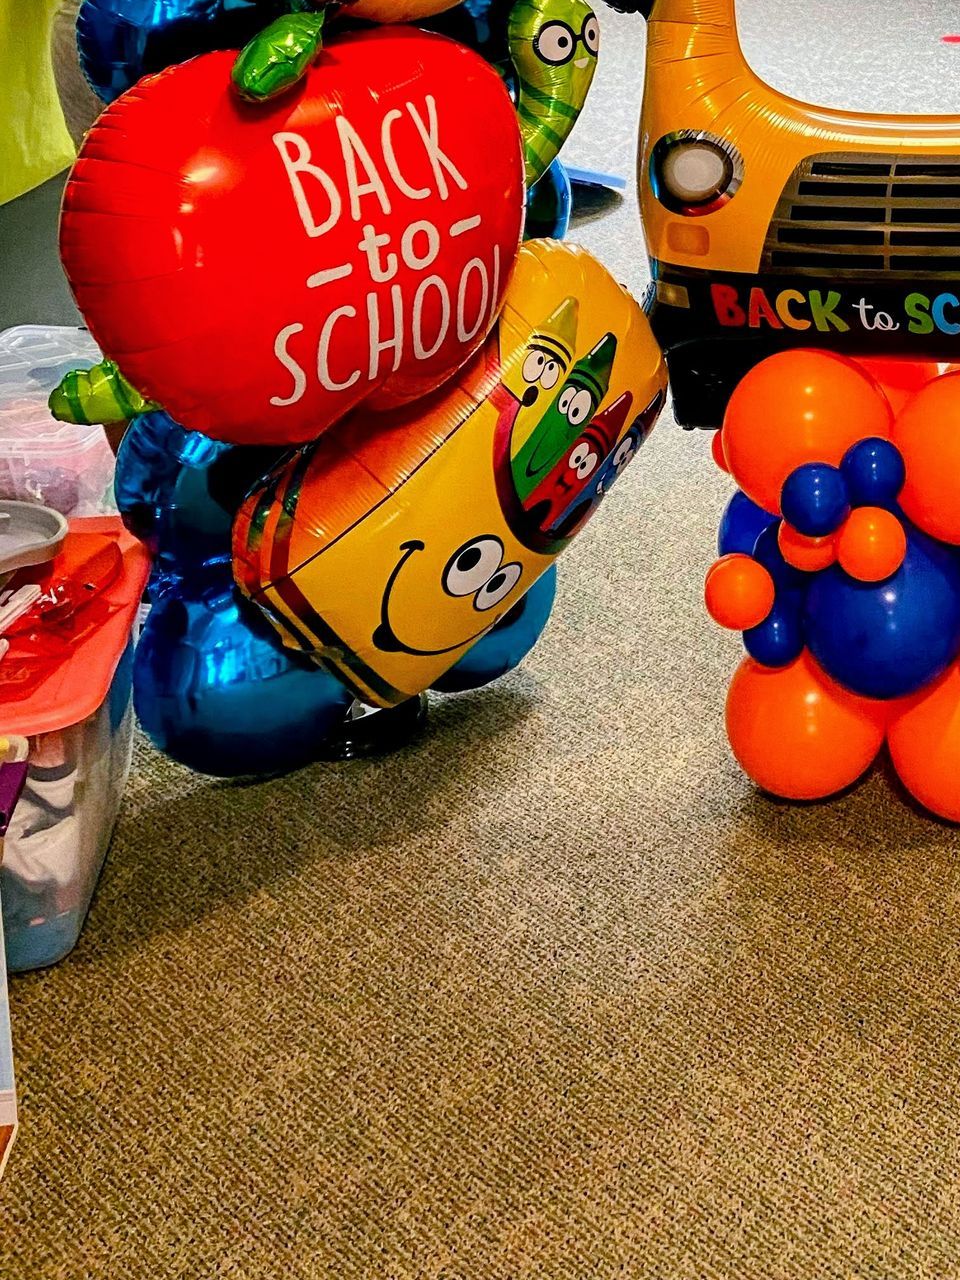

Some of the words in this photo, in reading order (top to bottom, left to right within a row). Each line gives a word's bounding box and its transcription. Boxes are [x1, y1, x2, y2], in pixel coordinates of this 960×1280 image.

[272, 94, 468, 238] BACK
[710, 283, 851, 333] BACK
[852, 296, 900, 332] to
